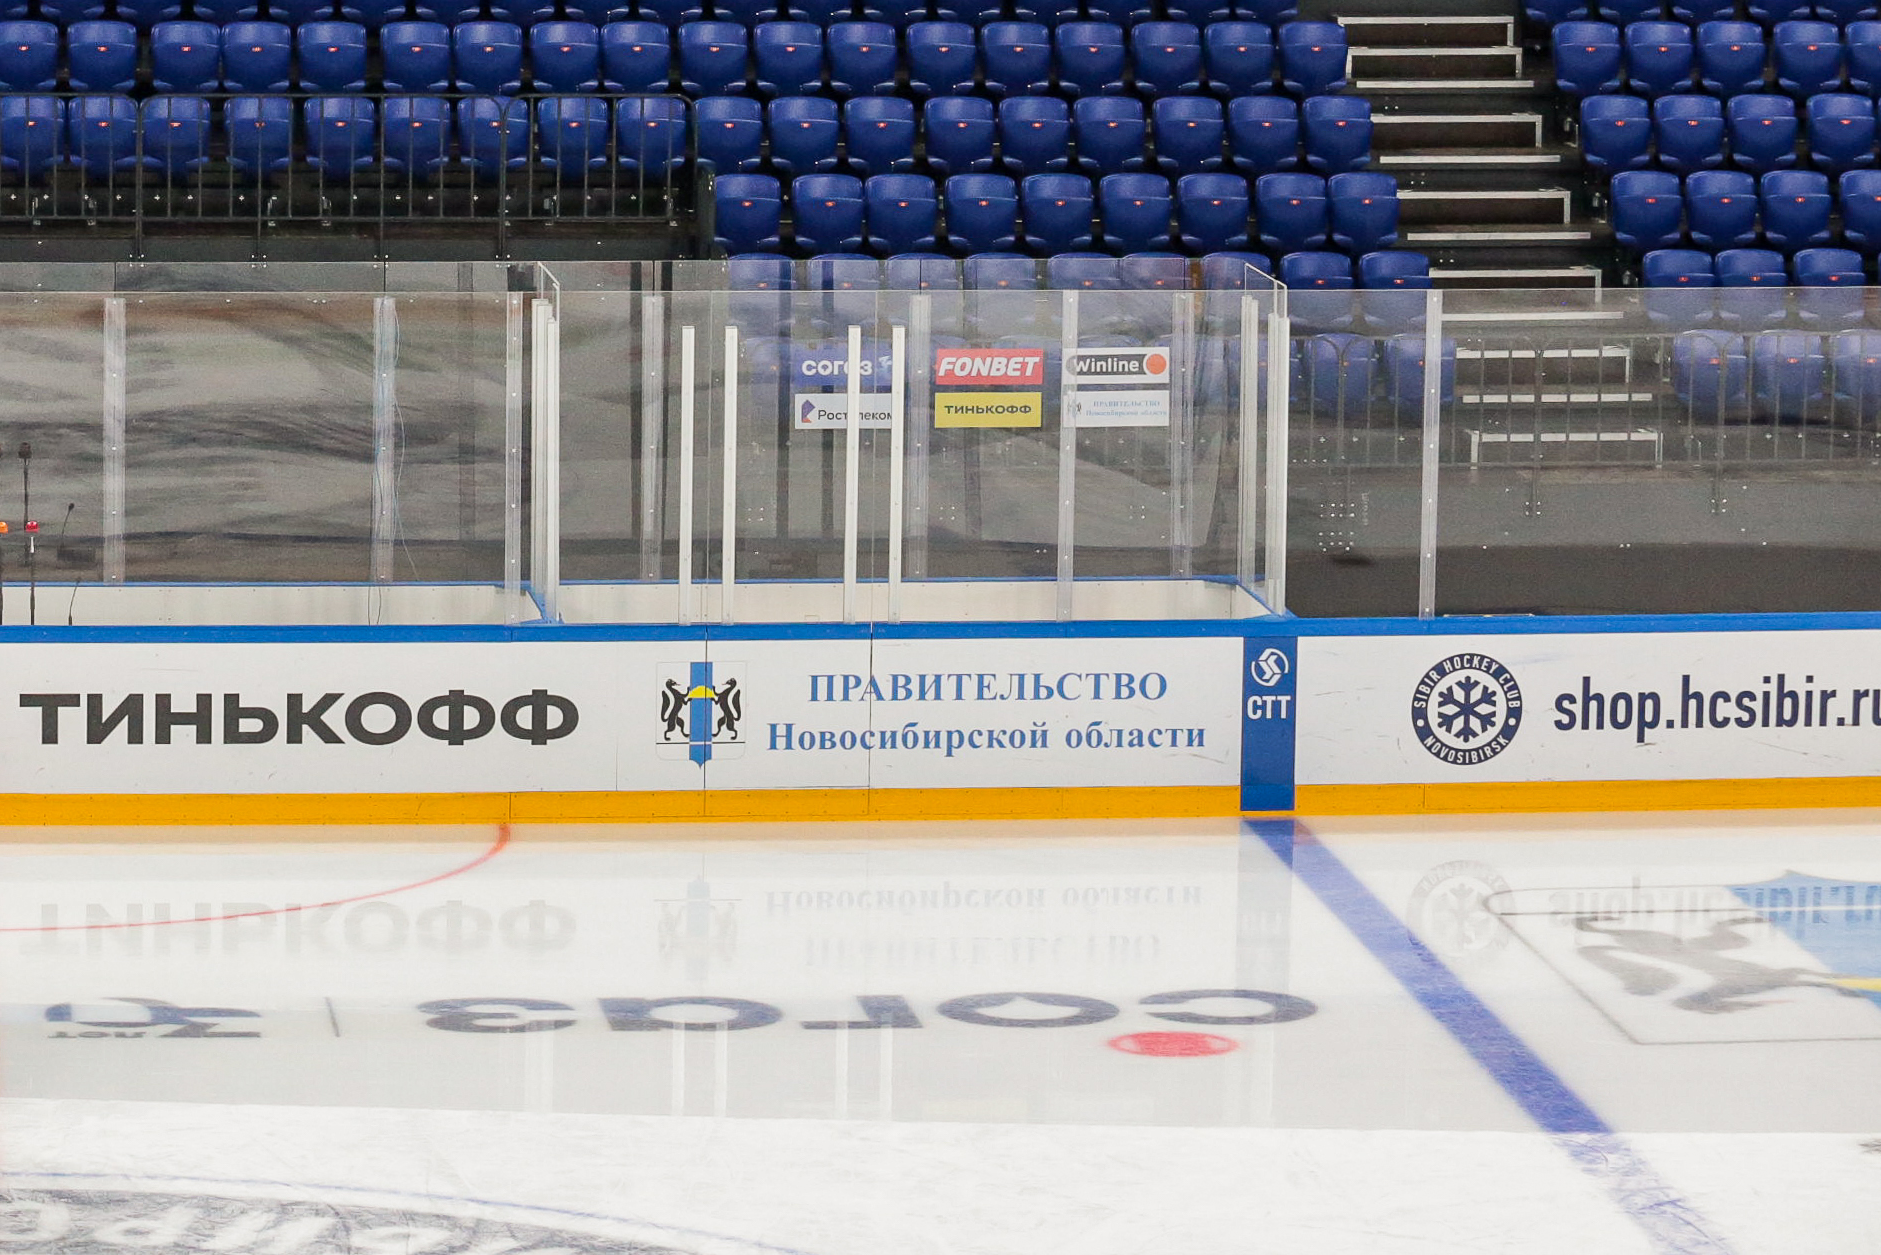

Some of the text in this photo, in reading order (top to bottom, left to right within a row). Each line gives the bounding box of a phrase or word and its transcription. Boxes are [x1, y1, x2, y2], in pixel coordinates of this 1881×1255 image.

[938, 356, 1040, 377] FONBET
[1073, 357, 1140, 373] Winline
[944, 405, 1032, 415] ТИНЬКОФФ
[808, 671, 1168, 703] ПРАВИТЕЛЬСТВО
[1414, 655, 1521, 708] SIBIR HOCKEY CLUB
[19, 689, 580, 746] ТИНЬКОФФ
[767, 721, 1206, 757] Новосибирской области
[1423, 734, 1509, 764] NOVOSIBIRSK
